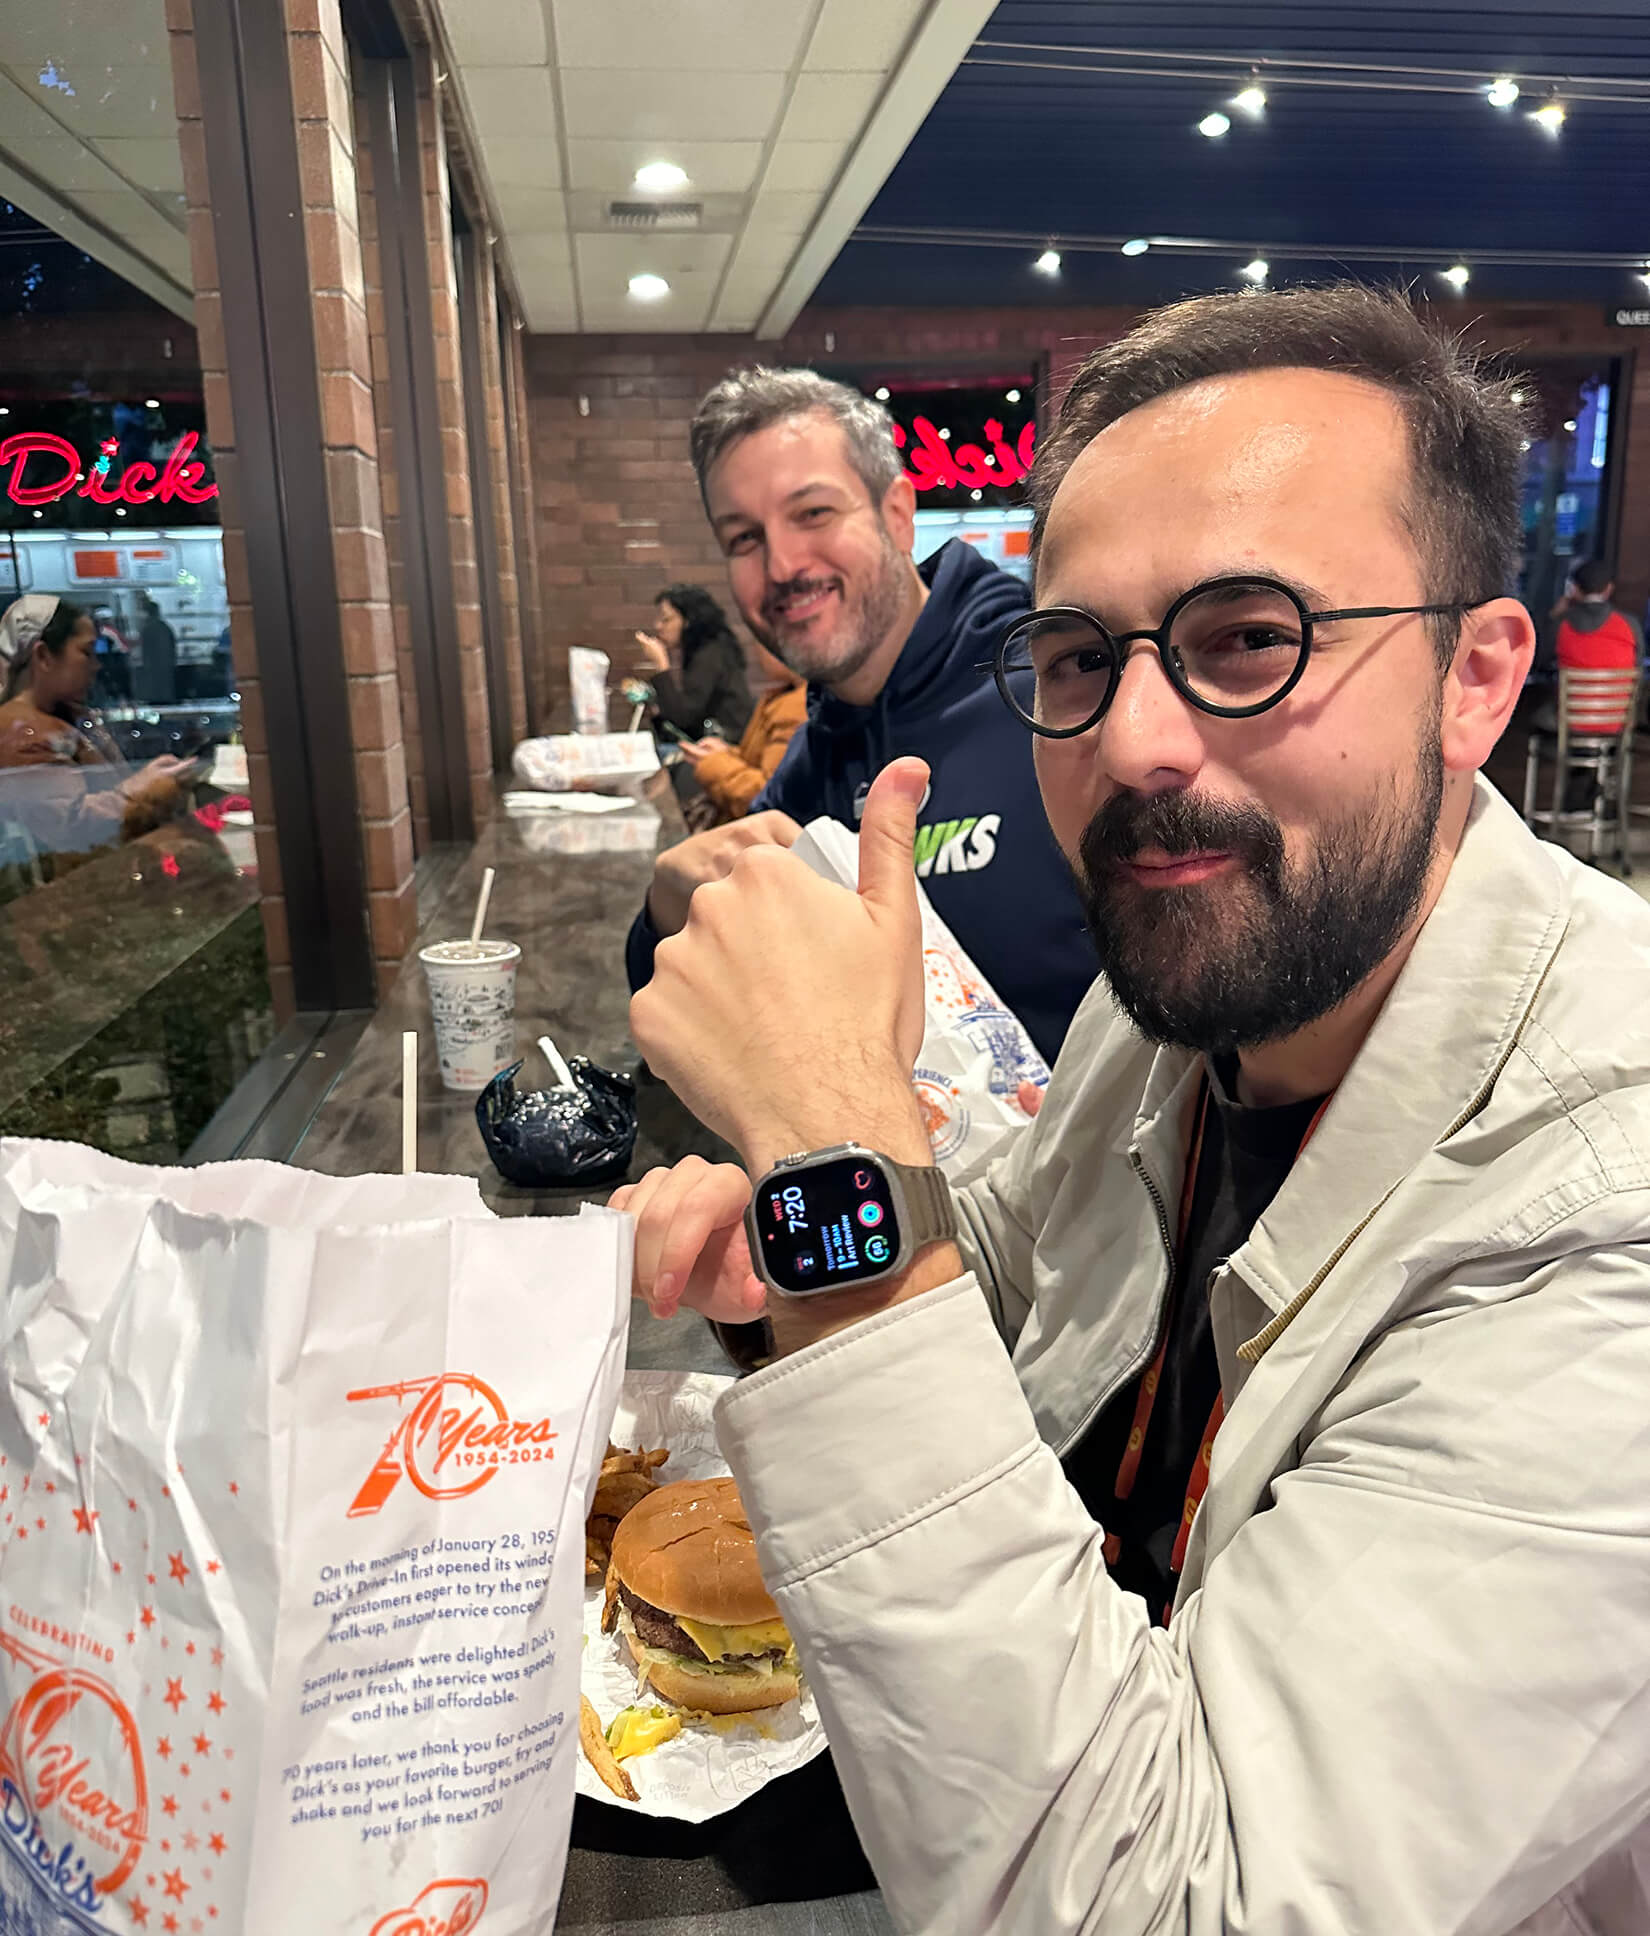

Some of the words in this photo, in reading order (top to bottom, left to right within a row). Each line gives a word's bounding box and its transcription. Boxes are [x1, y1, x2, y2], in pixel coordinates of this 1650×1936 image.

[782, 1186, 809, 1233] 7:20
[841, 1214, 855, 1246] Review
[820, 1225, 836, 1271] Tomorrow
[433, 1406, 558, 1474] Years
[455, 1447, 554, 1467] 1954-2024
[313, 1583, 354, 1606] Dick's
[357, 1569, 408, 1594] Drive-In
[411, 1564, 433, 1580] first
[437, 1556, 490, 1577] opened
[495, 1557, 511, 1572] its
[320, 1565, 341, 1581] On
[345, 1560, 366, 1575] the
[370, 1547, 418, 1570] morning
[422, 1539, 436, 1555] of
[437, 1538, 496, 1554] January
[501, 1533, 525, 1550] 28,
[345, 1594, 412, 1616] customers
[416, 1585, 452, 1603] eager
[457, 1582, 471, 1595] to
[476, 1582, 496, 1598] try
[500, 1577, 522, 1593] the
[327, 1623, 388, 1644] walk-up,
[393, 1608, 436, 1630] instant
[438, 1602, 489, 1618] service
[301, 1690, 331, 1716] food
[335, 1688, 362, 1702] was
[367, 1677, 408, 1696] fresh,
[413, 1674, 433, 1689] the
[436, 1670, 487, 1686] service
[492, 1669, 520, 1682] was
[523, 1650, 556, 1679] speedy
[302, 1668, 348, 1694] Seattle
[353, 1658, 415, 1679] residents
[419, 1652, 451, 1666] were
[457, 1642, 529, 1665] delighted!
[531, 1626, 555, 1653] Dick's
[352, 1703, 381, 1722] and
[386, 1700, 409, 1717] the
[413, 1695, 434, 1713] bill
[437, 1688, 519, 1708] affordable.
[292, 1778, 339, 1802] Dick's
[343, 1781, 360, 1793] as
[366, 1775, 401, 1794] your
[405, 1762, 459, 1785] favorite
[464, 1757, 512, 1777] burger,
[515, 1746, 532, 1761] fry
[535, 1730, 556, 1752] and
[304, 1759, 347, 1780] years
[353, 1753, 391, 1769] later,
[397, 1749, 417, 1762] we
[422, 1738, 459, 1758] thank
[464, 1740, 491, 1757] you
[496, 1732, 515, 1748] for
[518, 1711, 564, 1740] choosing
[35, 1743, 149, 1842] Years
[292, 1801, 337, 1824] shake
[342, 1797, 373, 1816] and
[378, 1799, 399, 1812] we
[405, 1786, 433, 1808] look
[437, 1777, 496, 1801] forward
[499, 1777, 512, 1790] to
[514, 1757, 552, 1784] serving
[2, 1777, 104, 1912] Dick's
[362, 1823, 391, 1843] you
[397, 1816, 418, 1833] for
[422, 1810, 441, 1827] the
[446, 1808, 478, 1824] next
[481, 1797, 503, 1818] 70!
